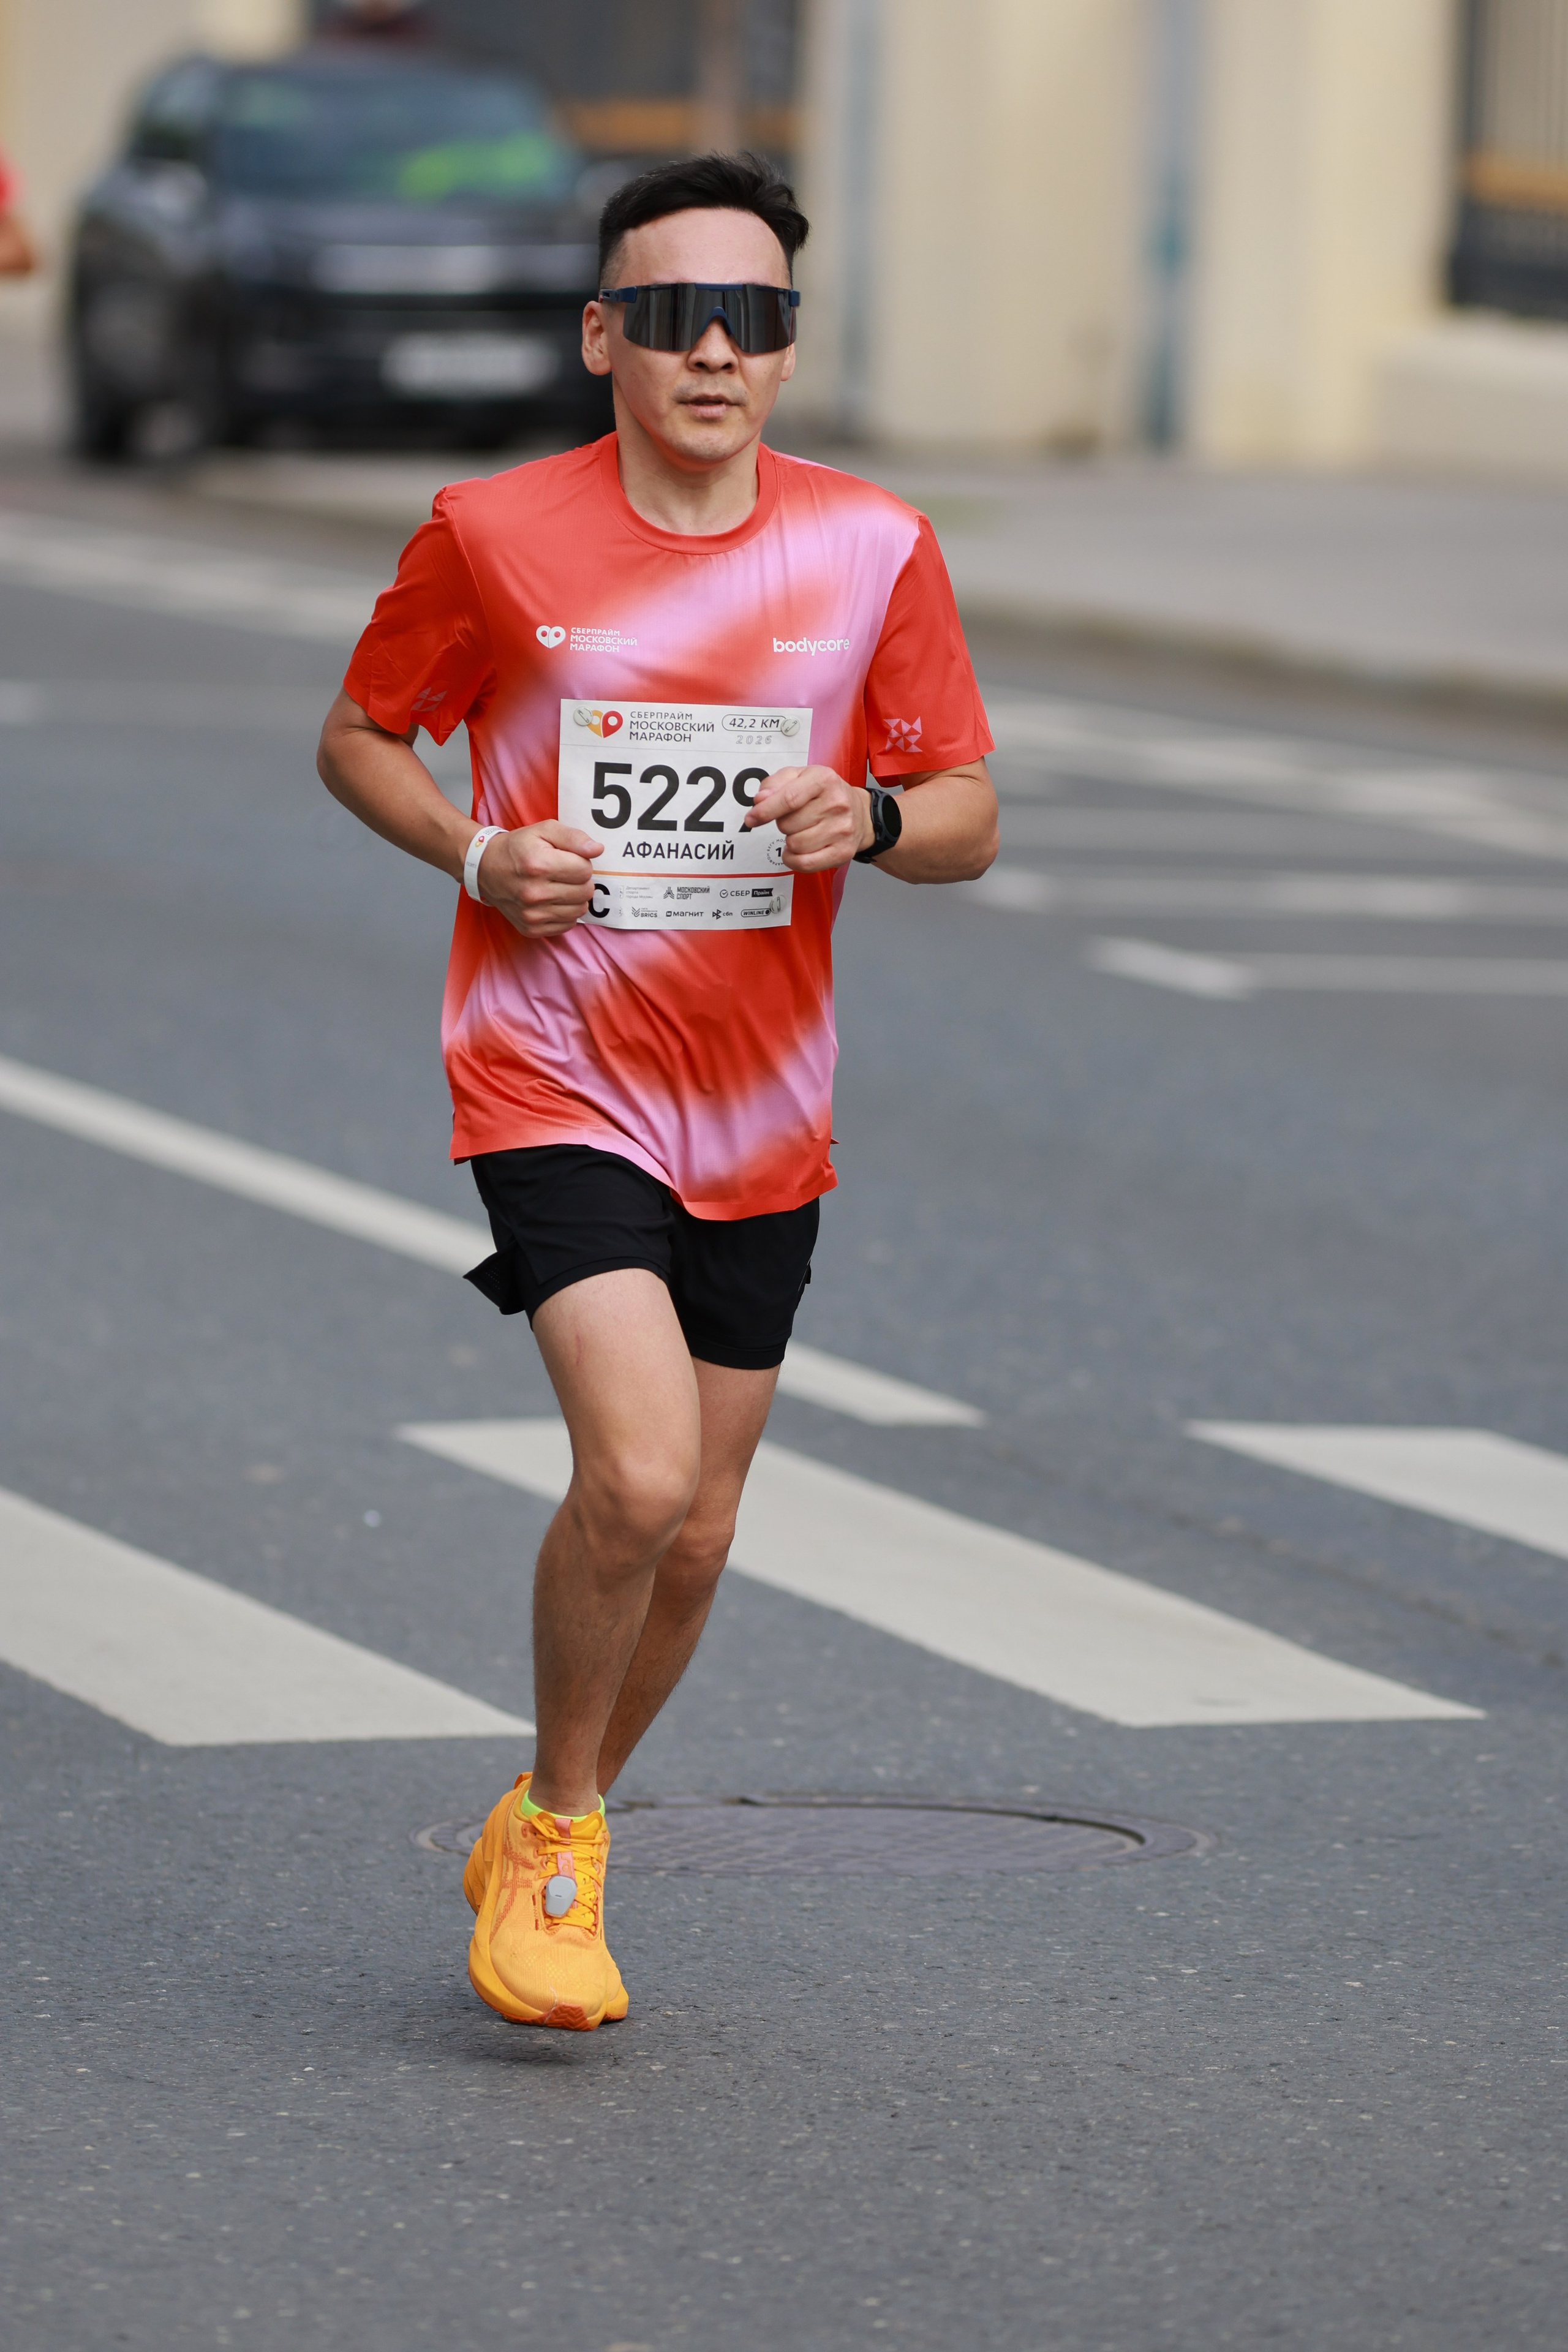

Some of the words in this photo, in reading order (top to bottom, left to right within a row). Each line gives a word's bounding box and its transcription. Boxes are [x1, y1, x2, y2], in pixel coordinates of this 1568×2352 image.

[570, 627, 620, 636] СБЕРПРАЙМ
[570, 634, 638, 646] МОСКОВСКИЙ
[570, 643, 620, 653] МАРАФОН
[772, 637, 850, 656] bodycore
[630, 711, 693, 720] СБЕРПРАЙМ
[630, 720, 715, 732] МОСКОВСКИЙ
[729, 718, 756, 729] 42,2
[629, 731, 692, 742] МАРАФОН
[736, 734, 772, 745] 2026
[591, 761, 771, 833] 5229
[622, 840, 735, 860] АФАНАСИЙ
